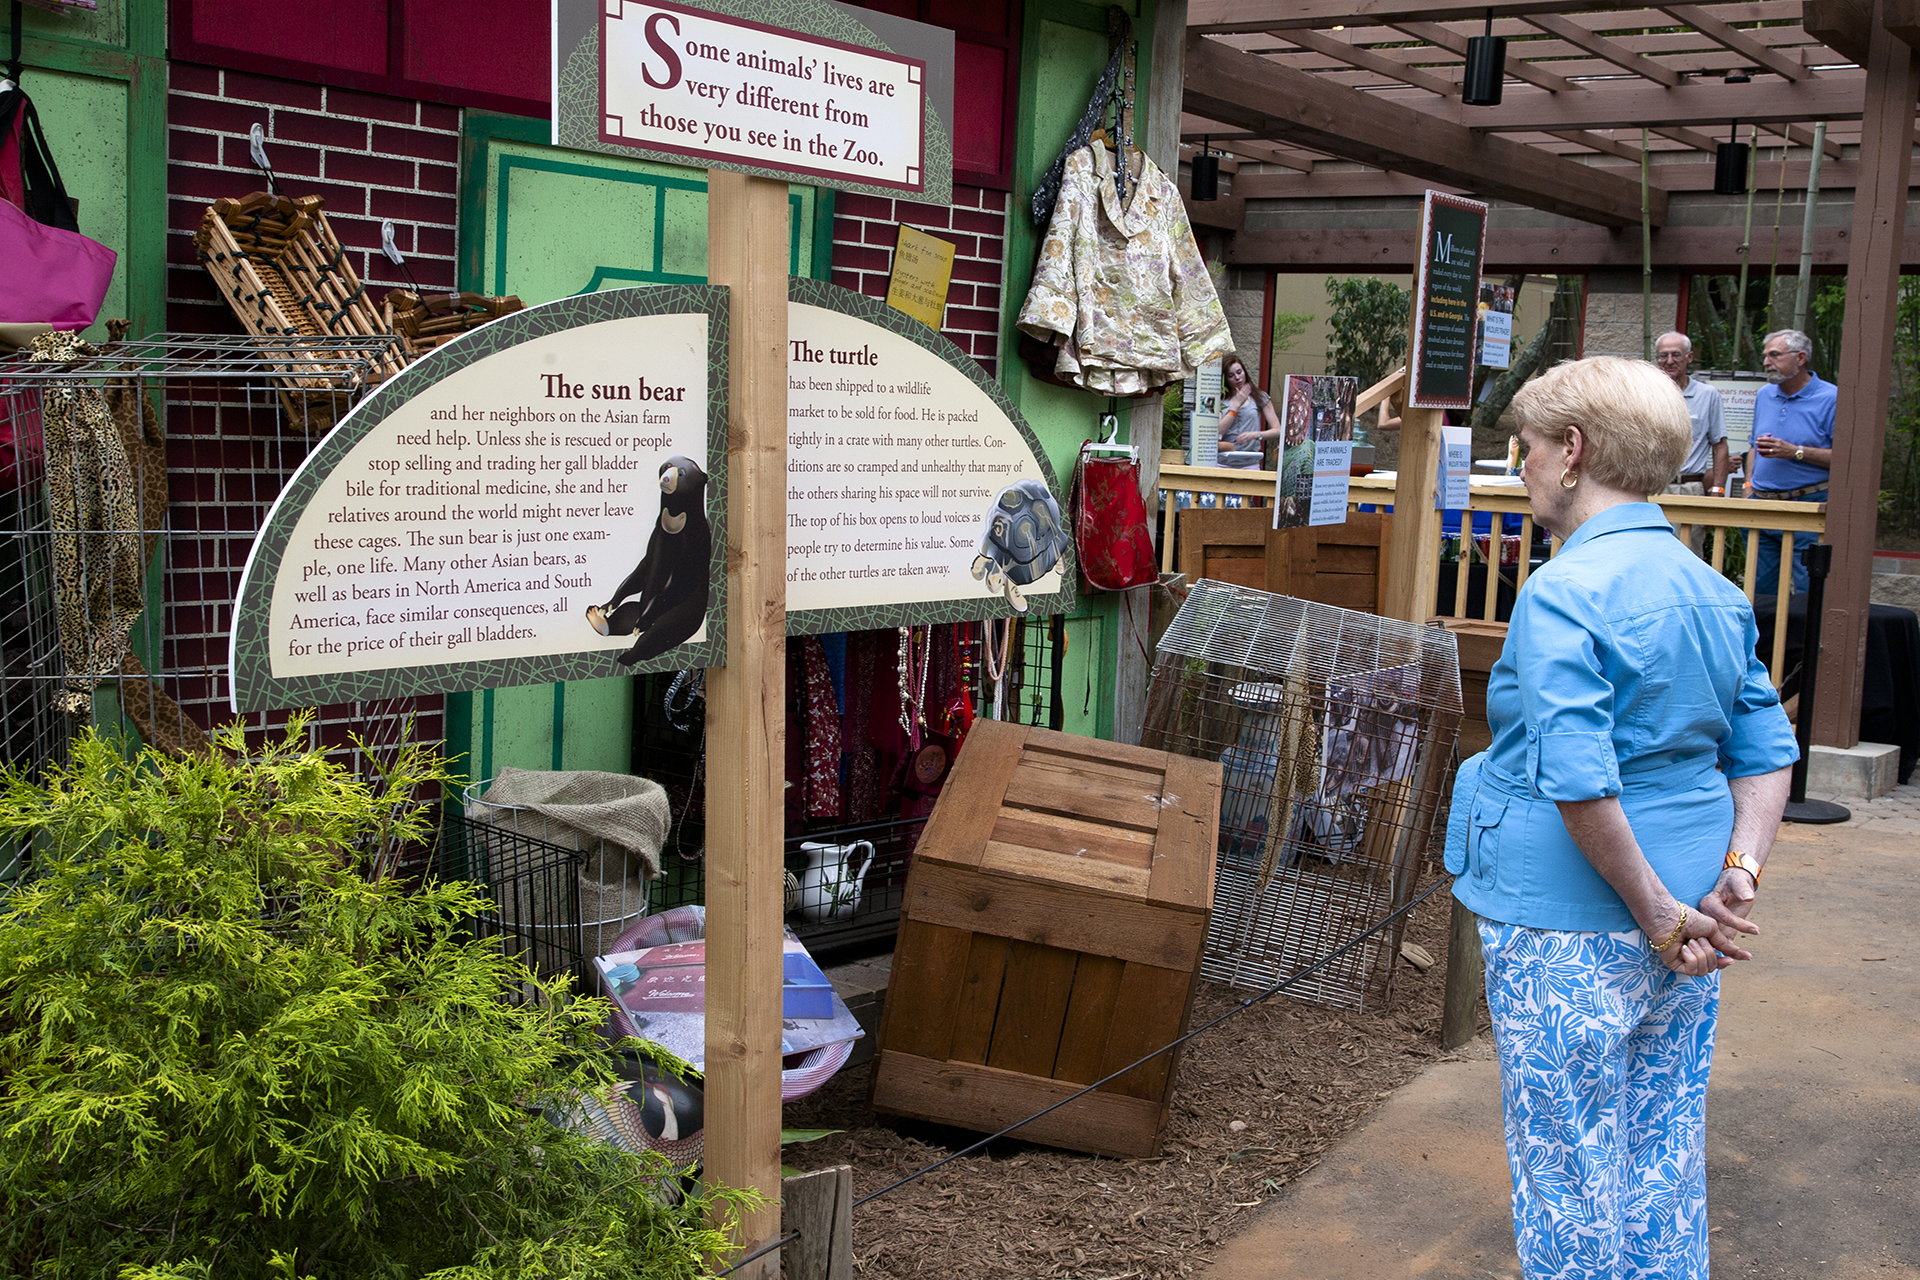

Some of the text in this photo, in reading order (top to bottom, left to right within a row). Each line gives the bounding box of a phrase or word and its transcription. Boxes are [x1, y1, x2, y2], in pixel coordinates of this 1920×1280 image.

[641, 12, 731, 90] Some
[823, 61, 863, 91] lives
[868, 80, 895, 98] are
[684, 79, 869, 128] very different from
[639, 102, 884, 166] those you see in the Zoo.
[788, 340, 878, 366] The turtle
[540, 373, 686, 402] The sun bear
[789, 375, 932, 396] has been shipped to a wildlife
[430, 404, 671, 427] and her neighbors on the Asian farm
[789, 404, 978, 426] market to be sold for food. He is packed
[396, 428, 672, 452] need help. Unless she is rescued or people
[788, 431, 1006, 450] tightly in a crate with many other turtles. Con-
[1318, 446, 1347, 454] WHAT ANIMALS
[368, 454, 639, 476] stop selling and trading her gall bladder
[788, 458, 1024, 476] ditions are so cramped and unhealthy that many of
[346, 478, 628, 497] bile for traditional medicine, she and her
[328, 501, 634, 524] relatives around the world might never leave
[314, 528, 611, 554] these cages. The sun bear is just one exam-
[644, 989, 694, 999] Welcome
